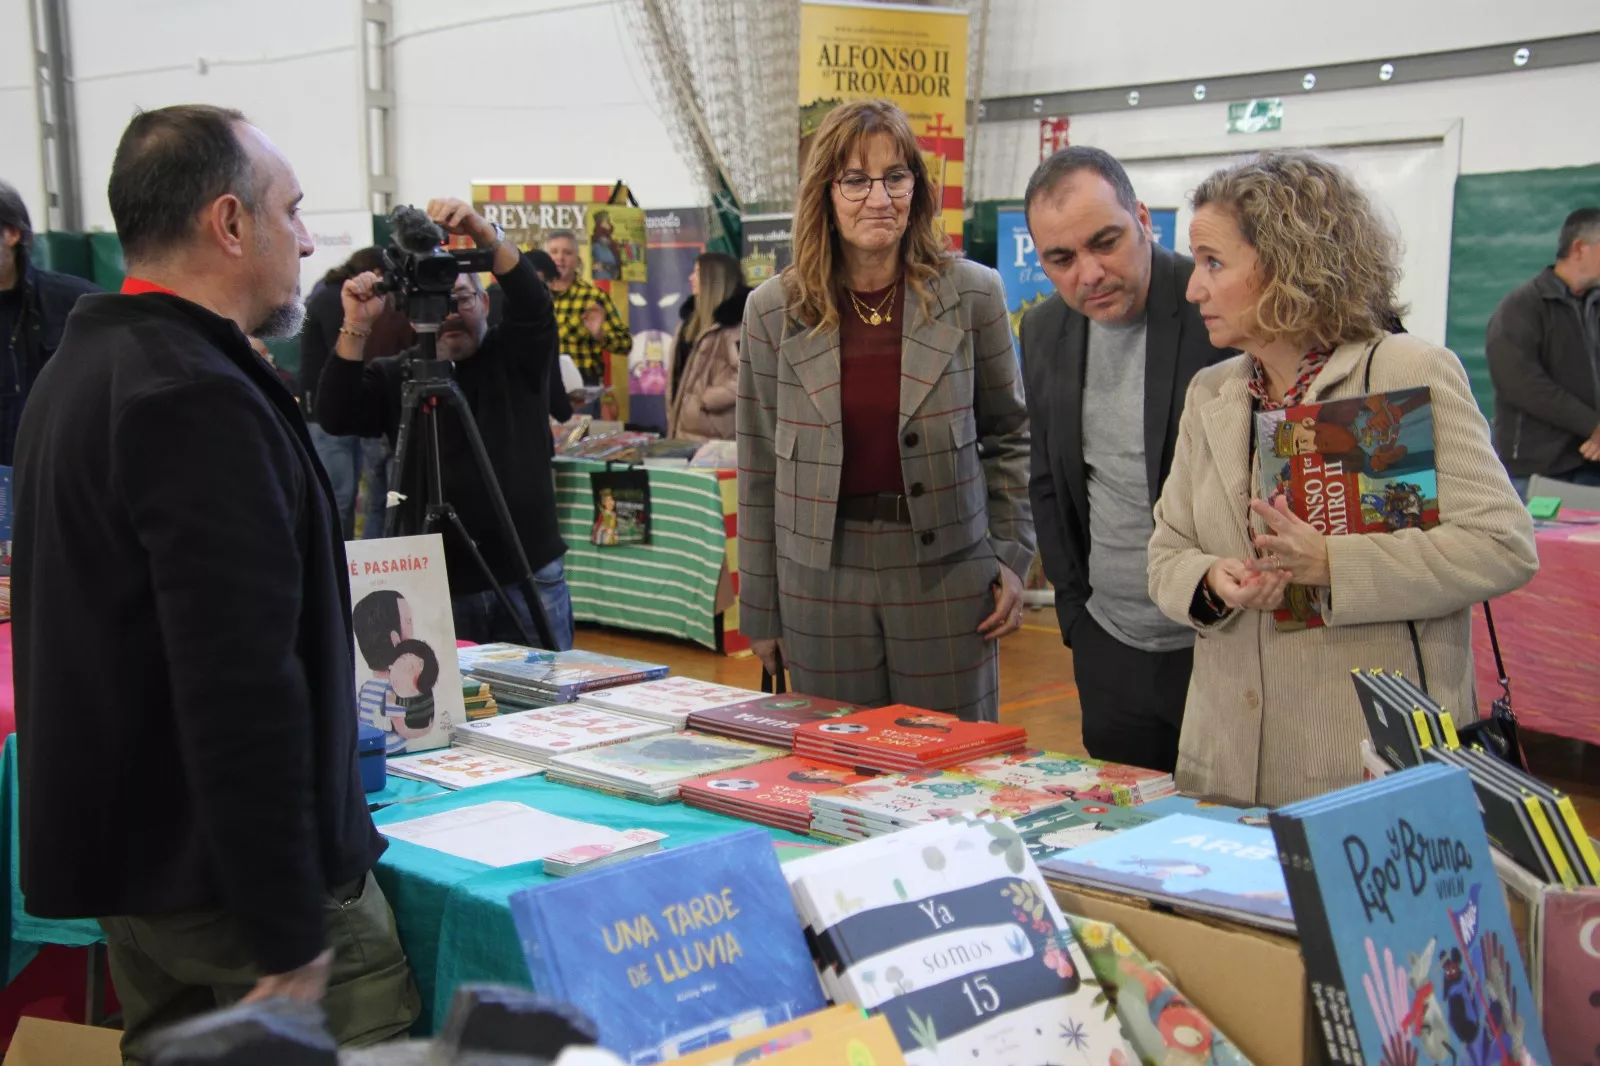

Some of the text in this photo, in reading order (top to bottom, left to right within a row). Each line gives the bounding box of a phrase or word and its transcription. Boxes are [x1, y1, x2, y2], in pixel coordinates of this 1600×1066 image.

[817, 43, 950, 74] ALFONSO II
[832, 69, 951, 97] TROVADOR
[483, 204, 529, 230] REY
[539, 204, 589, 230] REY
[1304, 478, 1327, 536] ONSO
[1323, 460, 1349, 536] MIRO II
[348, 553, 429, 576] É PASARÍA?
[1342, 834, 1401, 925] Pipo
[1385, 825, 1401, 861] y
[1397, 817, 1473, 897] Bruma
[601, 886, 741, 955] UNA TARDE
[917, 899, 956, 929] Ya
[626, 931, 745, 989] DE LLUVIA
[921, 940, 994, 975] somos
[962, 974, 1001, 1017] 15
